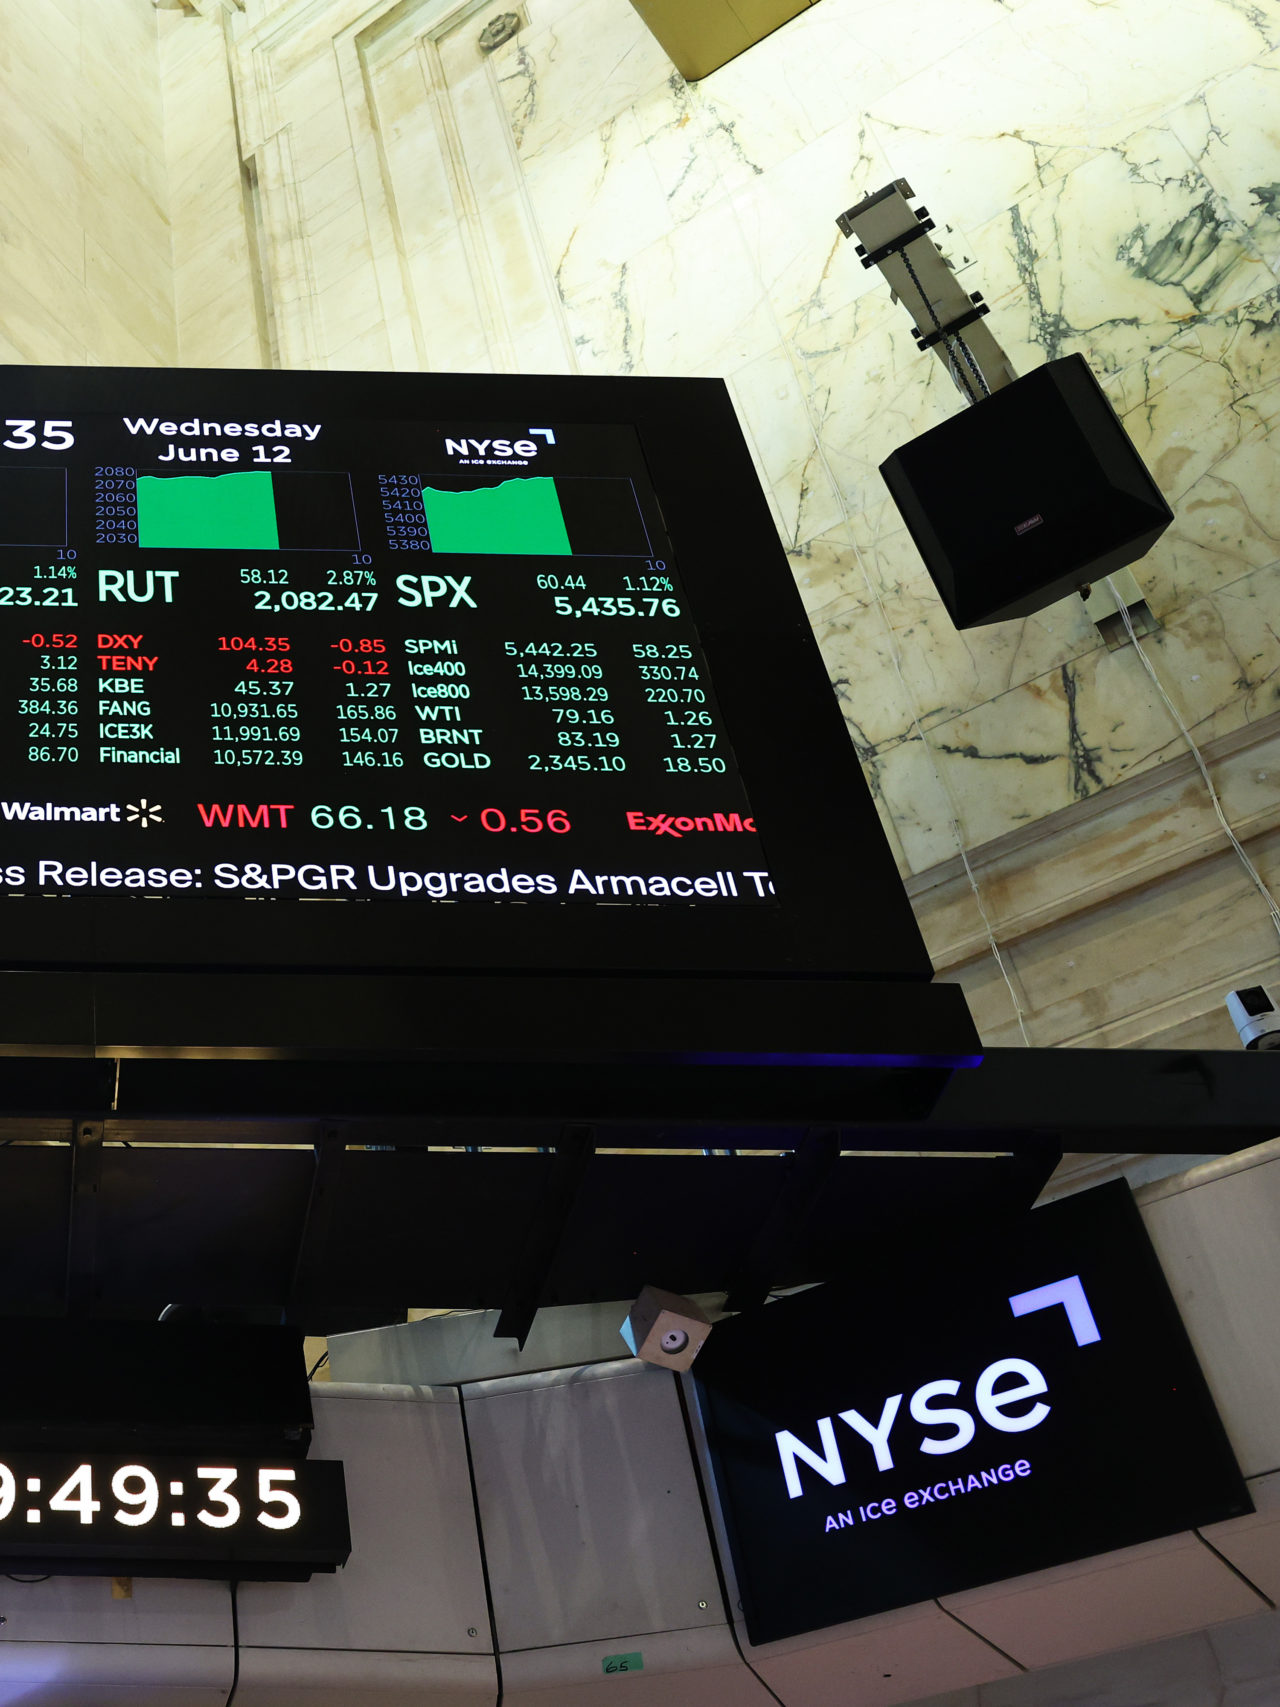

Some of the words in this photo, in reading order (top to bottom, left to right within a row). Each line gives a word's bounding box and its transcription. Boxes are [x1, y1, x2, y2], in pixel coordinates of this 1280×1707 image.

[123, 418, 321, 440] Wednesday
[158, 444, 239, 462] June
[252, 445, 291, 462] 12
[95, 467, 134, 476] 2080
[95, 480, 135, 489] 2070
[379, 474, 418, 486] 5430
[96, 493, 135, 502] 2060
[381, 487, 420, 497] 5420
[96, 506, 136, 516] 2050
[383, 500, 422, 510] 5410
[96, 520, 136, 529] 2040
[385, 513, 425, 523] 5400
[96, 533, 137, 543] 2030
[387, 526, 427, 536] 5390
[389, 540, 430, 550] 5380
[57, 550, 76, 559] 10
[352, 554, 372, 564] 10
[34, 566, 76, 578] 1.14%
[646, 560, 666, 570] 10
[241, 569, 288, 584] 58.12
[327, 570, 376, 585] 2.87%
[537, 575, 586, 589] 60.44
[623, 576, 673, 591] 1.12%
[99, 570, 179, 602] RUT
[396, 574, 477, 608] SPX
[254, 591, 378, 612] 2,082.47
[555, 597, 680, 618] 5,435.76
[23, 634, 77, 648] -0.52
[98, 634, 143, 648] DXY
[218, 637, 290, 651] 104.35
[331, 639, 386, 653] -0.85
[405, 639, 457, 654] SPMi
[505, 642, 597, 657] 5,442.25
[633, 644, 692, 658] 58.25
[41, 656, 77, 669] 3.12
[97, 656, 158, 671] TENY
[246, 659, 293, 673] 4.28
[334, 660, 389, 675] -0.12
[408, 661, 465, 676] Ice400
[517, 664, 602, 679] 14,399.09
[639, 666, 699, 680] 330.74
[30, 678, 77, 692] 35.68
[99, 678, 144, 693] KBE
[235, 681, 293, 695] 45.37
[346, 683, 390, 697] 1.27
[412, 683, 470, 698] Ice800
[522, 686, 608, 702] 13,598.29
[645, 688, 705, 703] 220.70
[19, 700, 78, 714] 384.36
[99, 700, 150, 716] FANG
[211, 703, 297, 719] 10,931.65
[337, 705, 396, 720] 165.86
[415, 706, 460, 721] WTI
[552, 709, 614, 724] 79.16
[665, 711, 712, 725] 1.26
[29, 723, 78, 738] 24.75
[100, 723, 153, 739] ICE3K
[213, 726, 300, 742] 11,991.69
[340, 728, 398, 743] 154.07
[420, 729, 482, 744] BRNT
[558, 732, 619, 747] 83.19
[671, 734, 716, 748] 1.27
[29, 747, 78, 762] 86.70
[100, 747, 180, 763] Financial
[214, 750, 302, 766] 10,572.39
[342, 752, 403, 767] 146.16
[424, 752, 491, 768] GOLD
[528, 755, 625, 772] 2,345.10
[664, 758, 725, 772] 18.50
[1, 802, 120, 822] Walmart
[197, 804, 294, 828] WMT
[311, 805, 427, 830] 66.18
[481, 808, 571, 833] 0.56
[39, 861, 202, 888] Release:
[214, 863, 357, 890] S&PGR
[368, 865, 558, 897] Upgrades
[569, 869, 737, 897] Armacell
[743, 872, 775, 897] T
[825, 1510, 855, 1532] AN
[606, 1661, 628, 1673] 65
